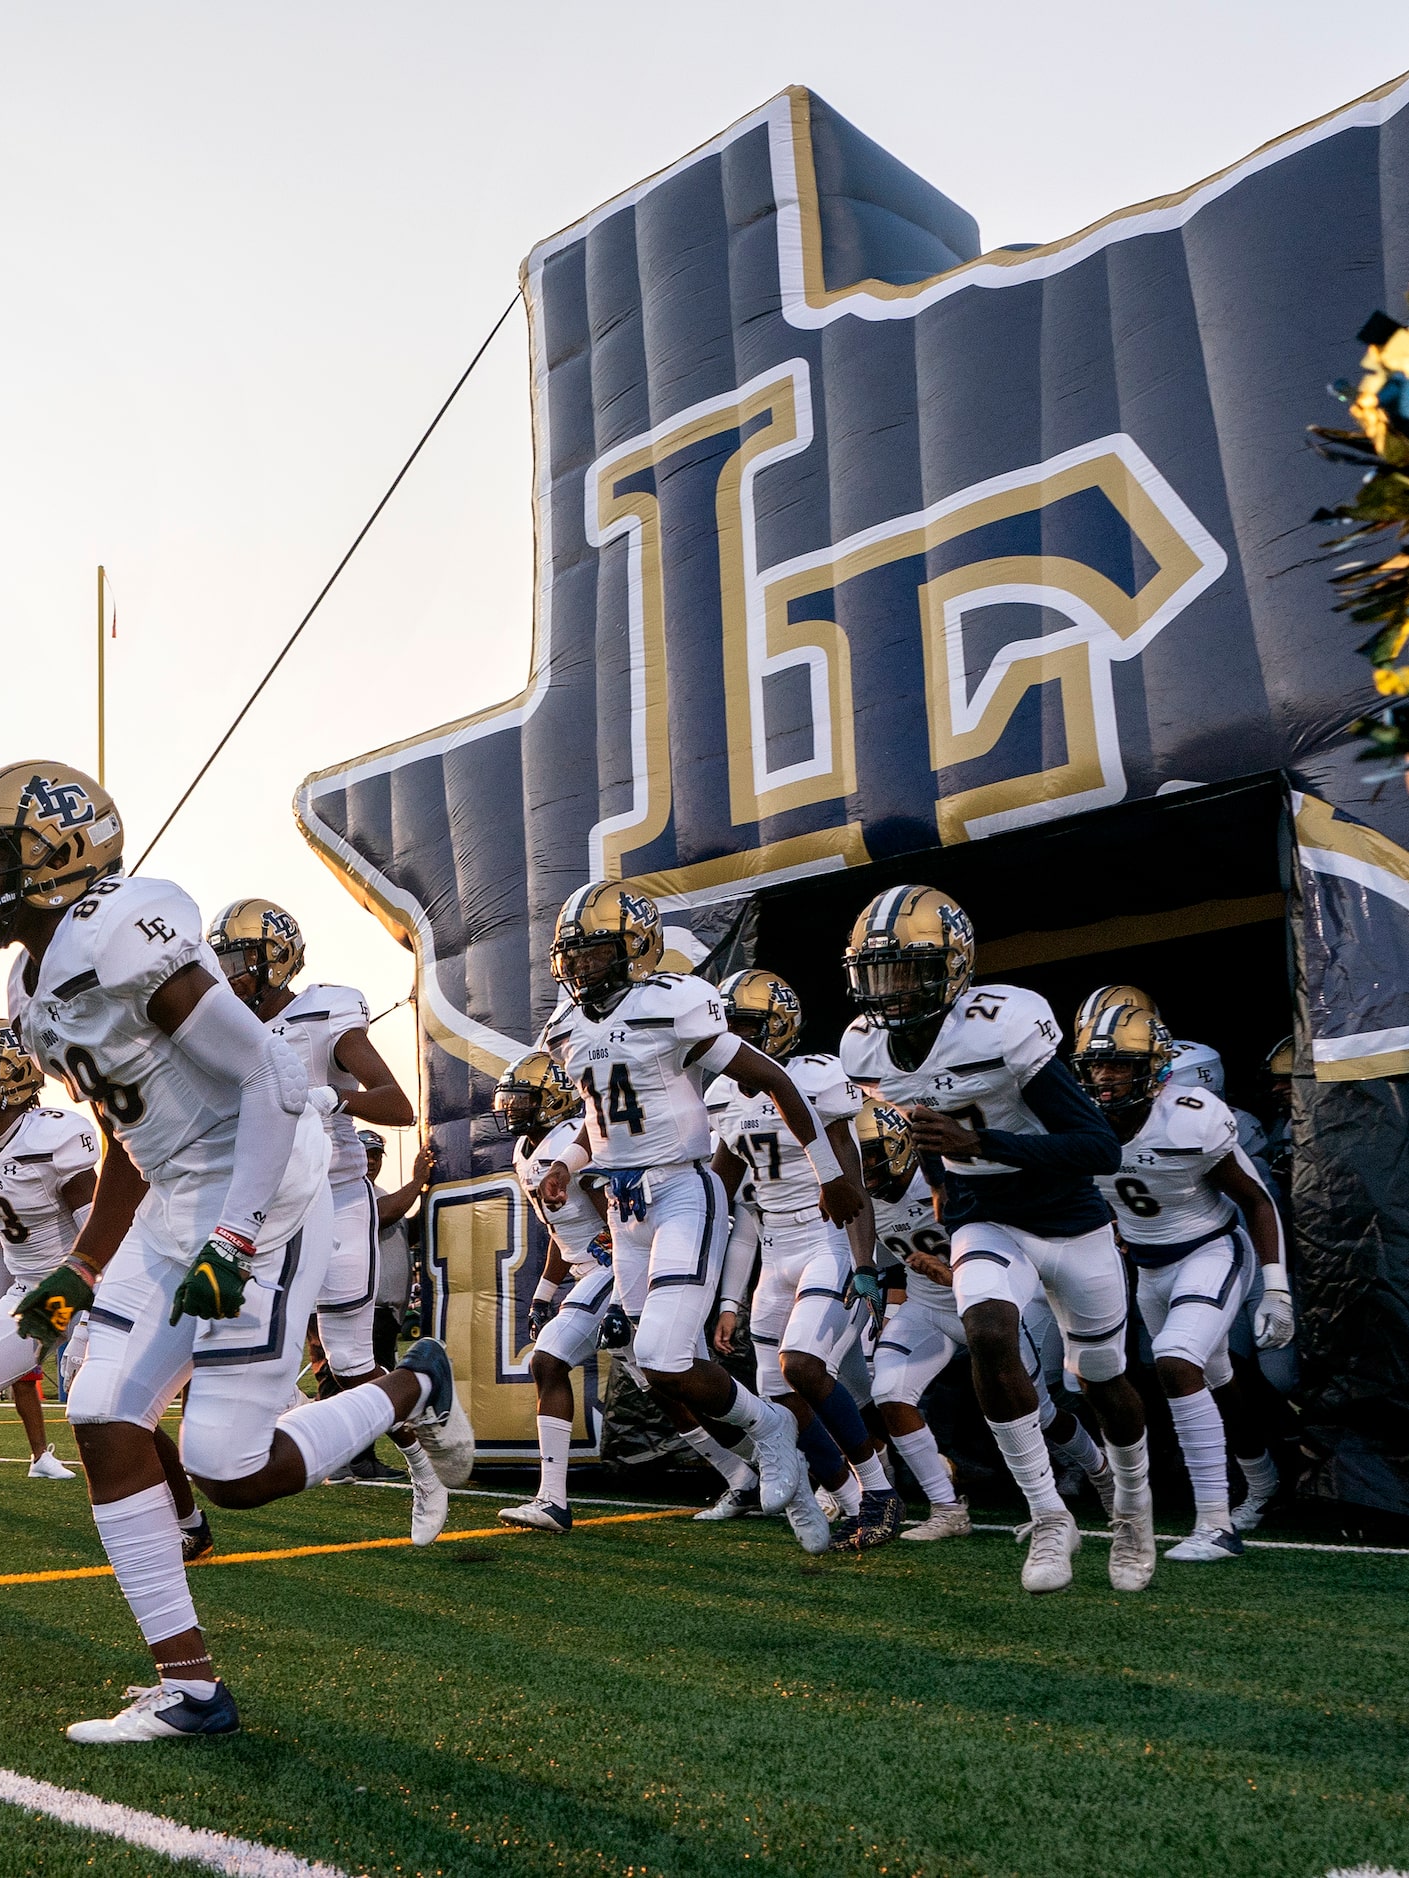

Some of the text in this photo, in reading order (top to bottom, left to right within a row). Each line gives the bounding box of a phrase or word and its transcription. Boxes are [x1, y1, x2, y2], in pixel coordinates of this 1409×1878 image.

[585, 357, 1228, 905] LE
[22, 779, 96, 831] LE
[261, 909, 299, 941] LE
[617, 894, 660, 929] LE
[937, 904, 974, 946] LE
[134, 916, 176, 945] LE
[706, 999, 722, 1022] LE
[766, 981, 799, 1013] LE
[965, 991, 1009, 1023] 27
[1034, 1018, 1057, 1042] LE
[588, 1048, 609, 1061] LOBOS
[1195, 1066, 1214, 1084] LE
[580, 1062, 647, 1138] 14
[845, 1081, 858, 1100] LE
[1175, 1095, 1205, 1110] 6
[740, 1119, 760, 1130] LOBOS
[79, 1134, 95, 1153] LE
[737, 1132, 781, 1182] 17
[1114, 1177, 1162, 1219] 6
[891, 1222, 912, 1233] LOBOS
